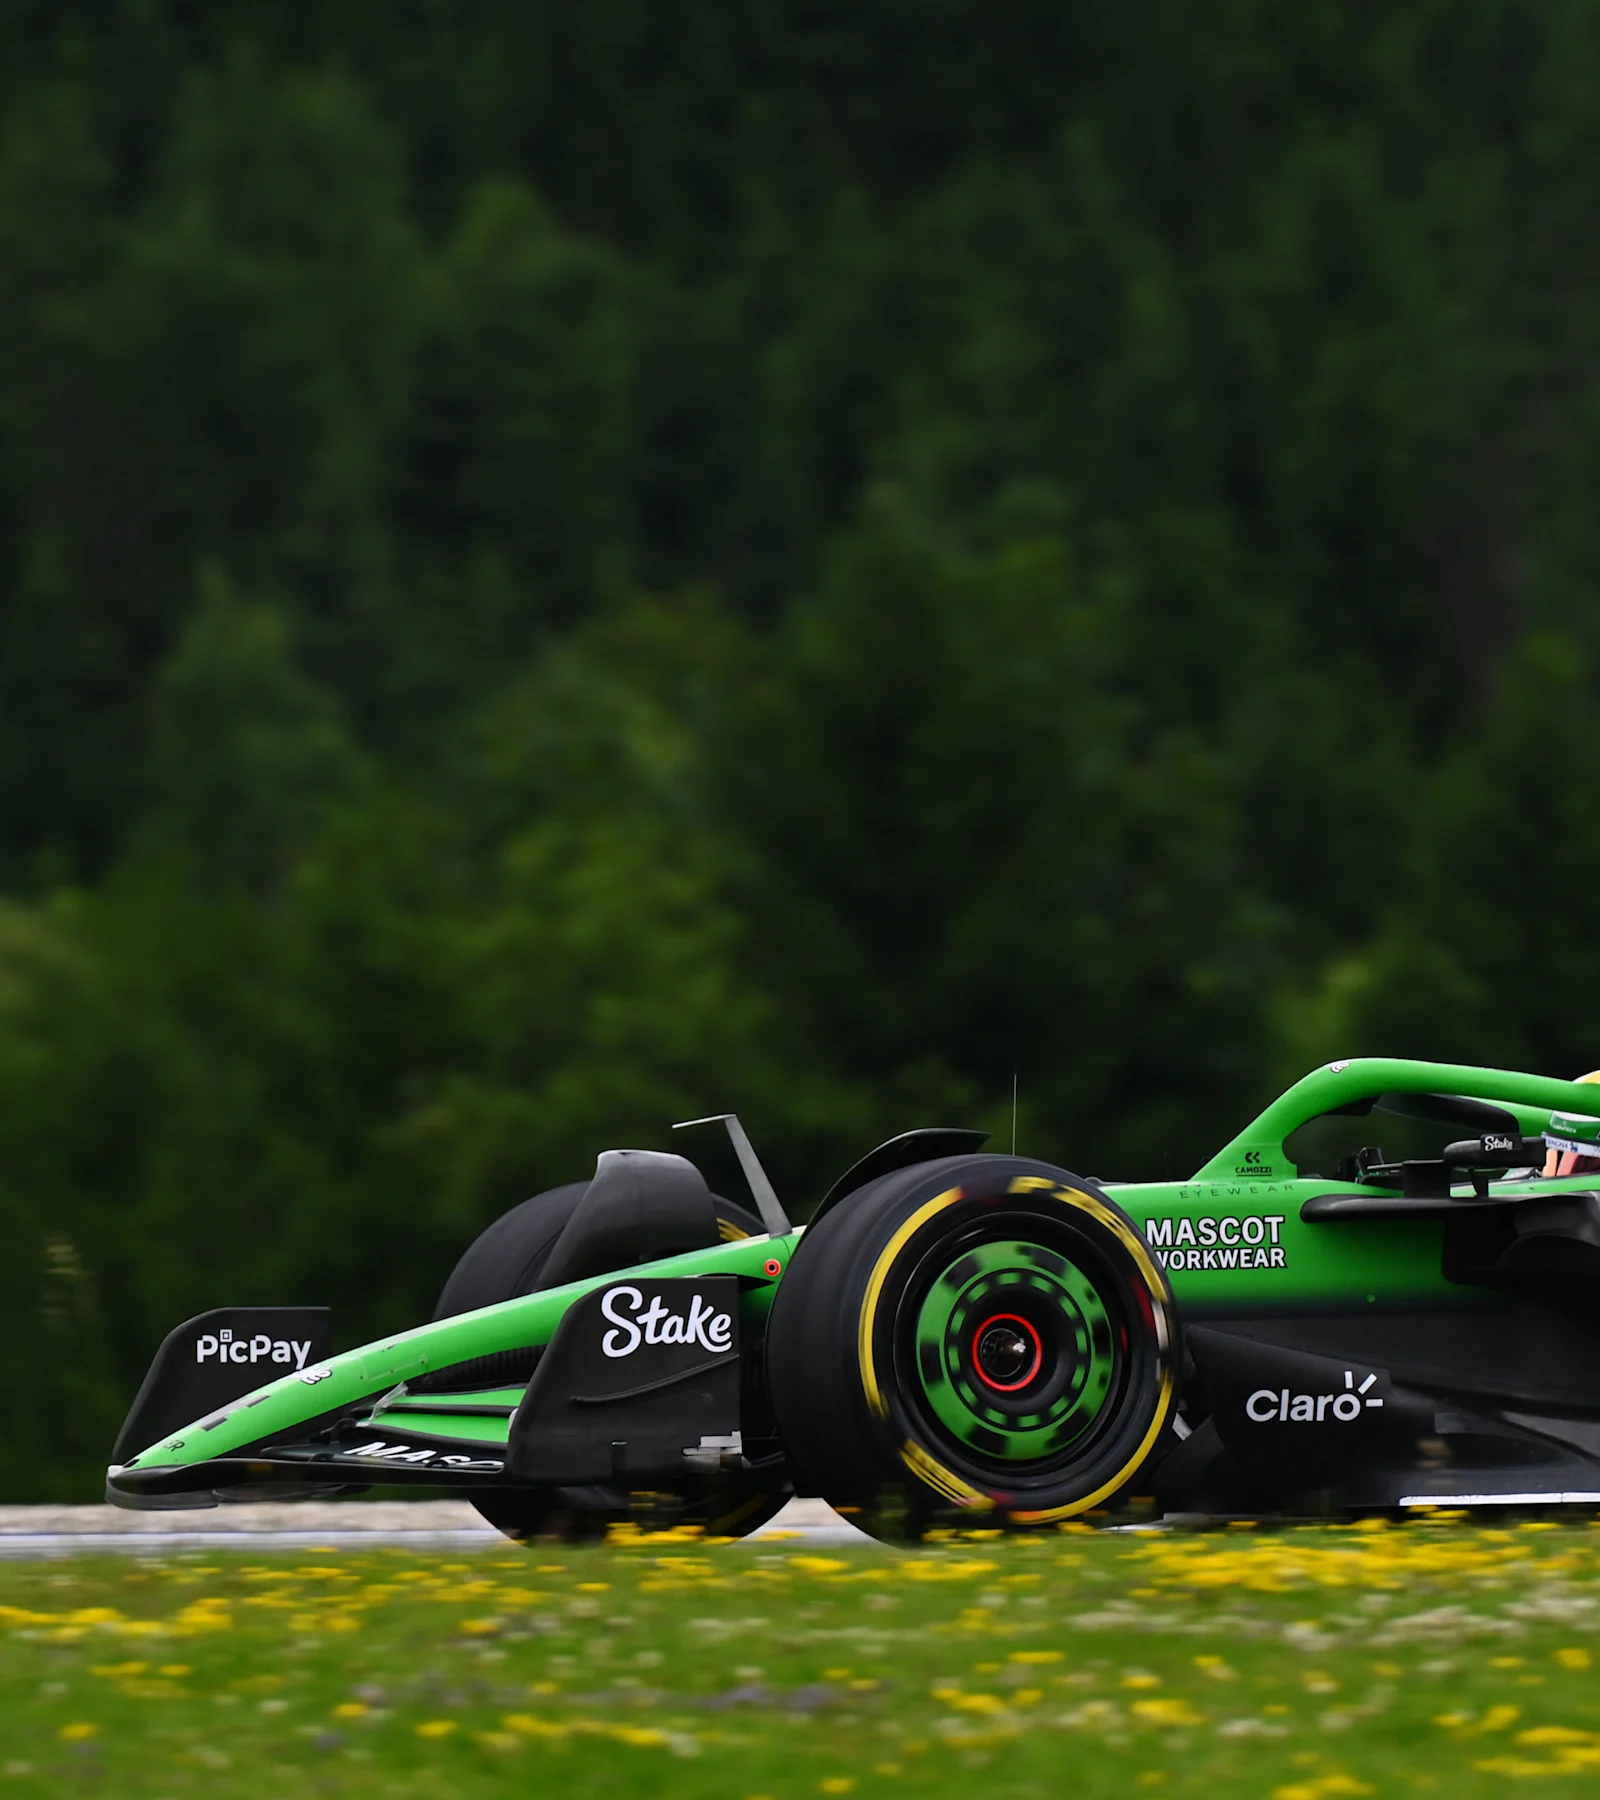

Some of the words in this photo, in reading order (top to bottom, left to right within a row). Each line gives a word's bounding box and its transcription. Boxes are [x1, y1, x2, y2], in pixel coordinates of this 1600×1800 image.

[1483, 1135, 1514, 1152] Stake
[1235, 1166, 1272, 1174] CAMOZZI
[1146, 1216, 1285, 1246] MASCOT
[601, 1286, 733, 1358] Stake
[196, 1329, 312, 1370] PicPay
[1246, 1388, 1361, 1422] Claro
